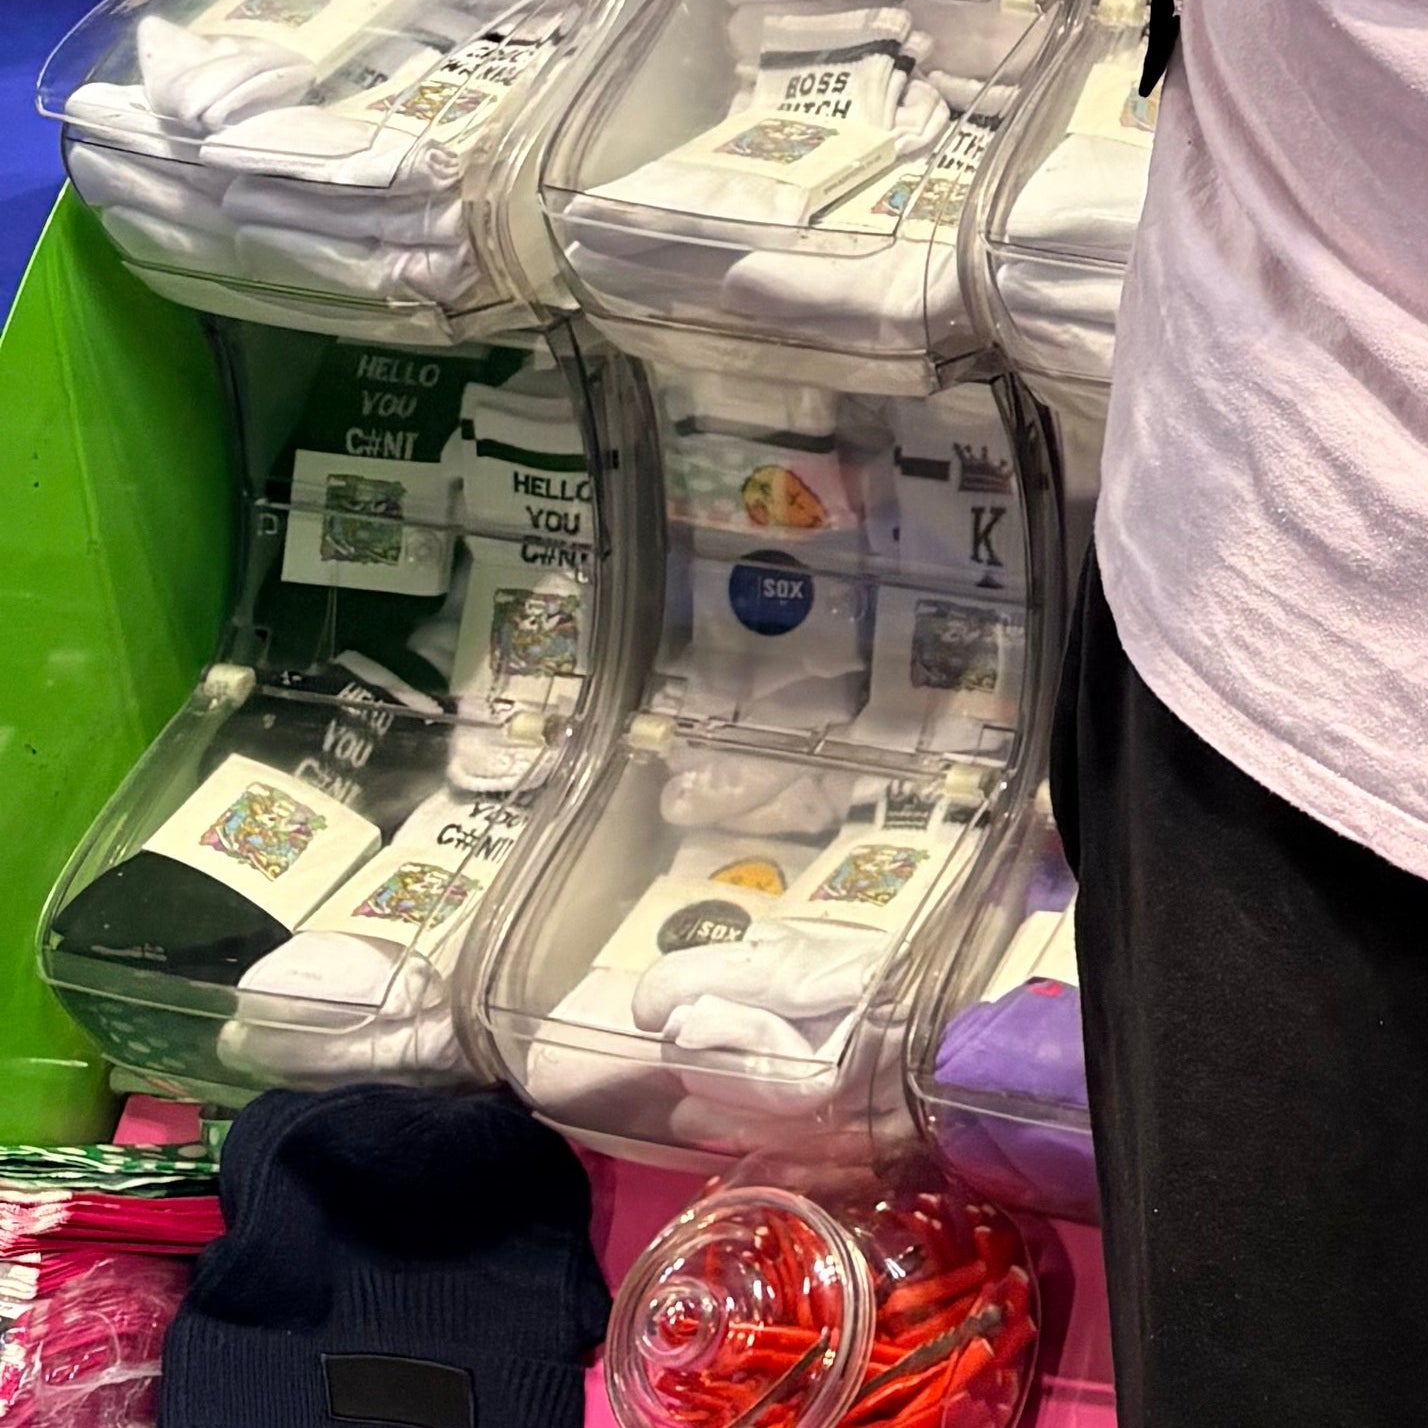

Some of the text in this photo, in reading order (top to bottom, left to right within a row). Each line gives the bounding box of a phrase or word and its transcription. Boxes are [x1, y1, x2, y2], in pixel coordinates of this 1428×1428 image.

[785, 70, 852, 100] BOSS
[355, 354, 442, 390] HELLO
[360, 388, 419, 419] YOU
[525, 505, 581, 537] YOU
[762, 577, 805, 600] SOX
[321, 719, 374, 769] YOU
